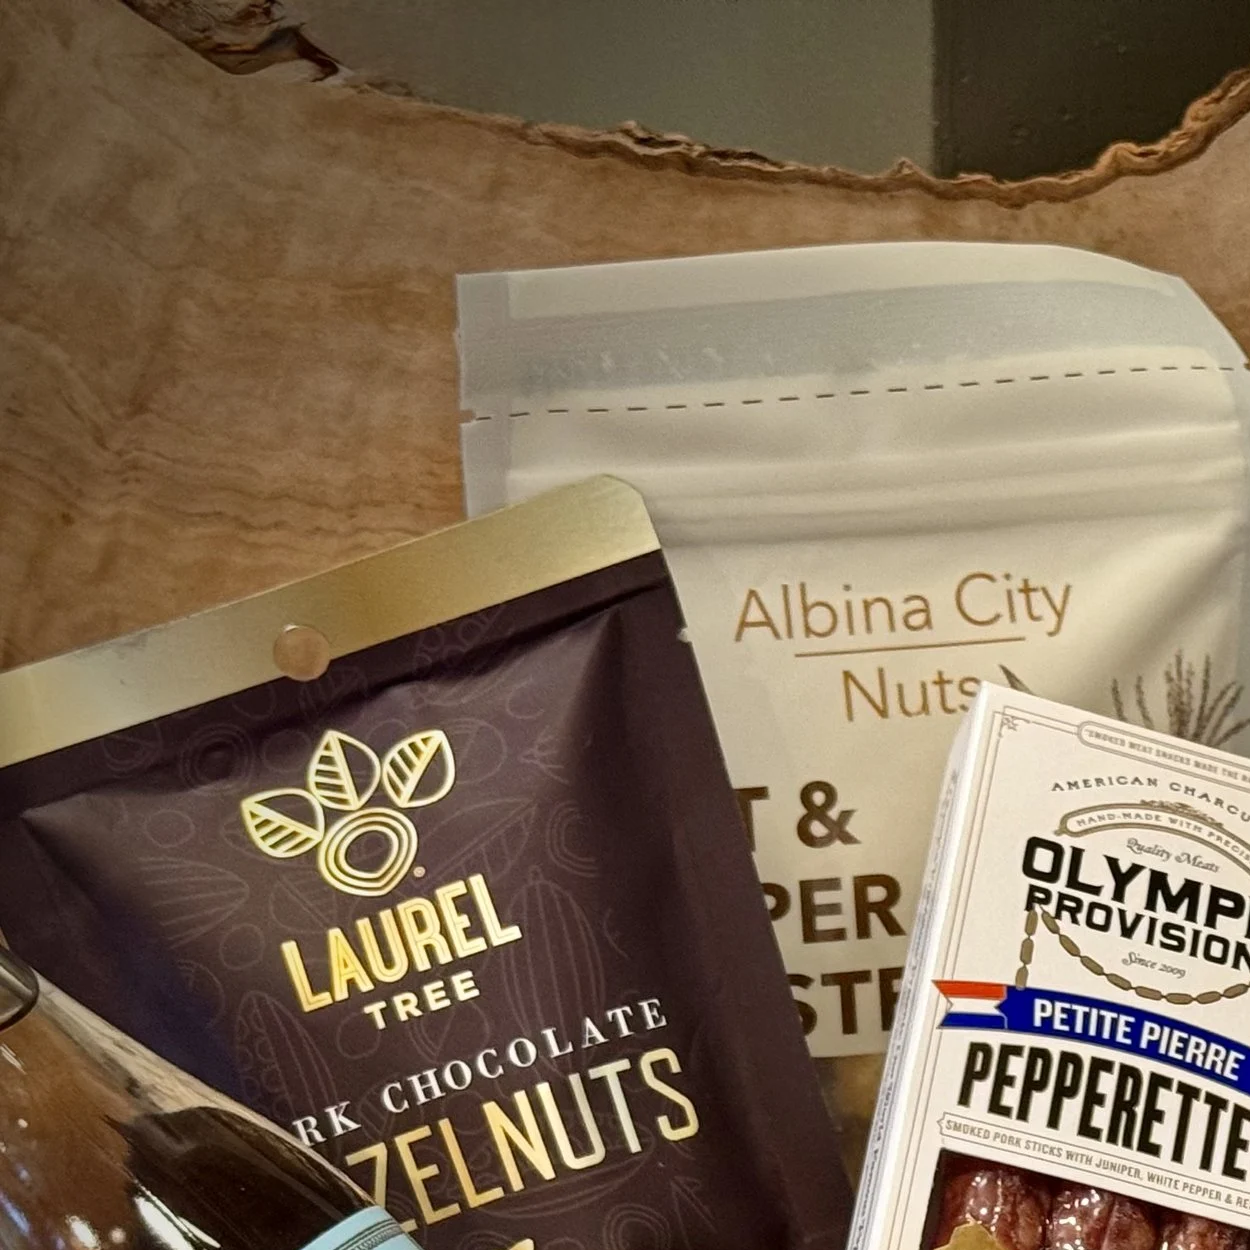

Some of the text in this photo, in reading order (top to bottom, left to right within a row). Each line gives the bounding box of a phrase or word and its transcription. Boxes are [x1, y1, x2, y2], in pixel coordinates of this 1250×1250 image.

[735, 572, 1071, 642] Albina City
[842, 667, 984, 722] Nuts
[797, 780, 862, 848] &
[1051, 775, 1158, 792] AMERICAN
[1076, 812, 1162, 828] HAND-MADE
[1167, 816, 1202, 834] WITH
[1126, 837, 1221, 873] Quality Meats
[281, 873, 523, 1013] LAUREL
[760, 873, 907, 944] PER
[1121, 951, 1186, 979] Since 2009
[364, 970, 480, 1030] TREE
[292, 998, 667, 1148] RK CHOCOLATE
[1033, 997, 1246, 1081] PETITE PIERRE
[345, 1047, 699, 1233] ZELNUTS
[945, 1119, 991, 1140] SMOKED
[993, 1130, 1021, 1148] PORK
[1024, 1140, 1063, 1158] STICKS
[1066, 1150, 1093, 1166] WITH
[1147, 1171, 1179, 1190] WHITE
[1182, 1182, 1222, 1202] PEPPER
[1224, 1194, 1233, 1205] &
